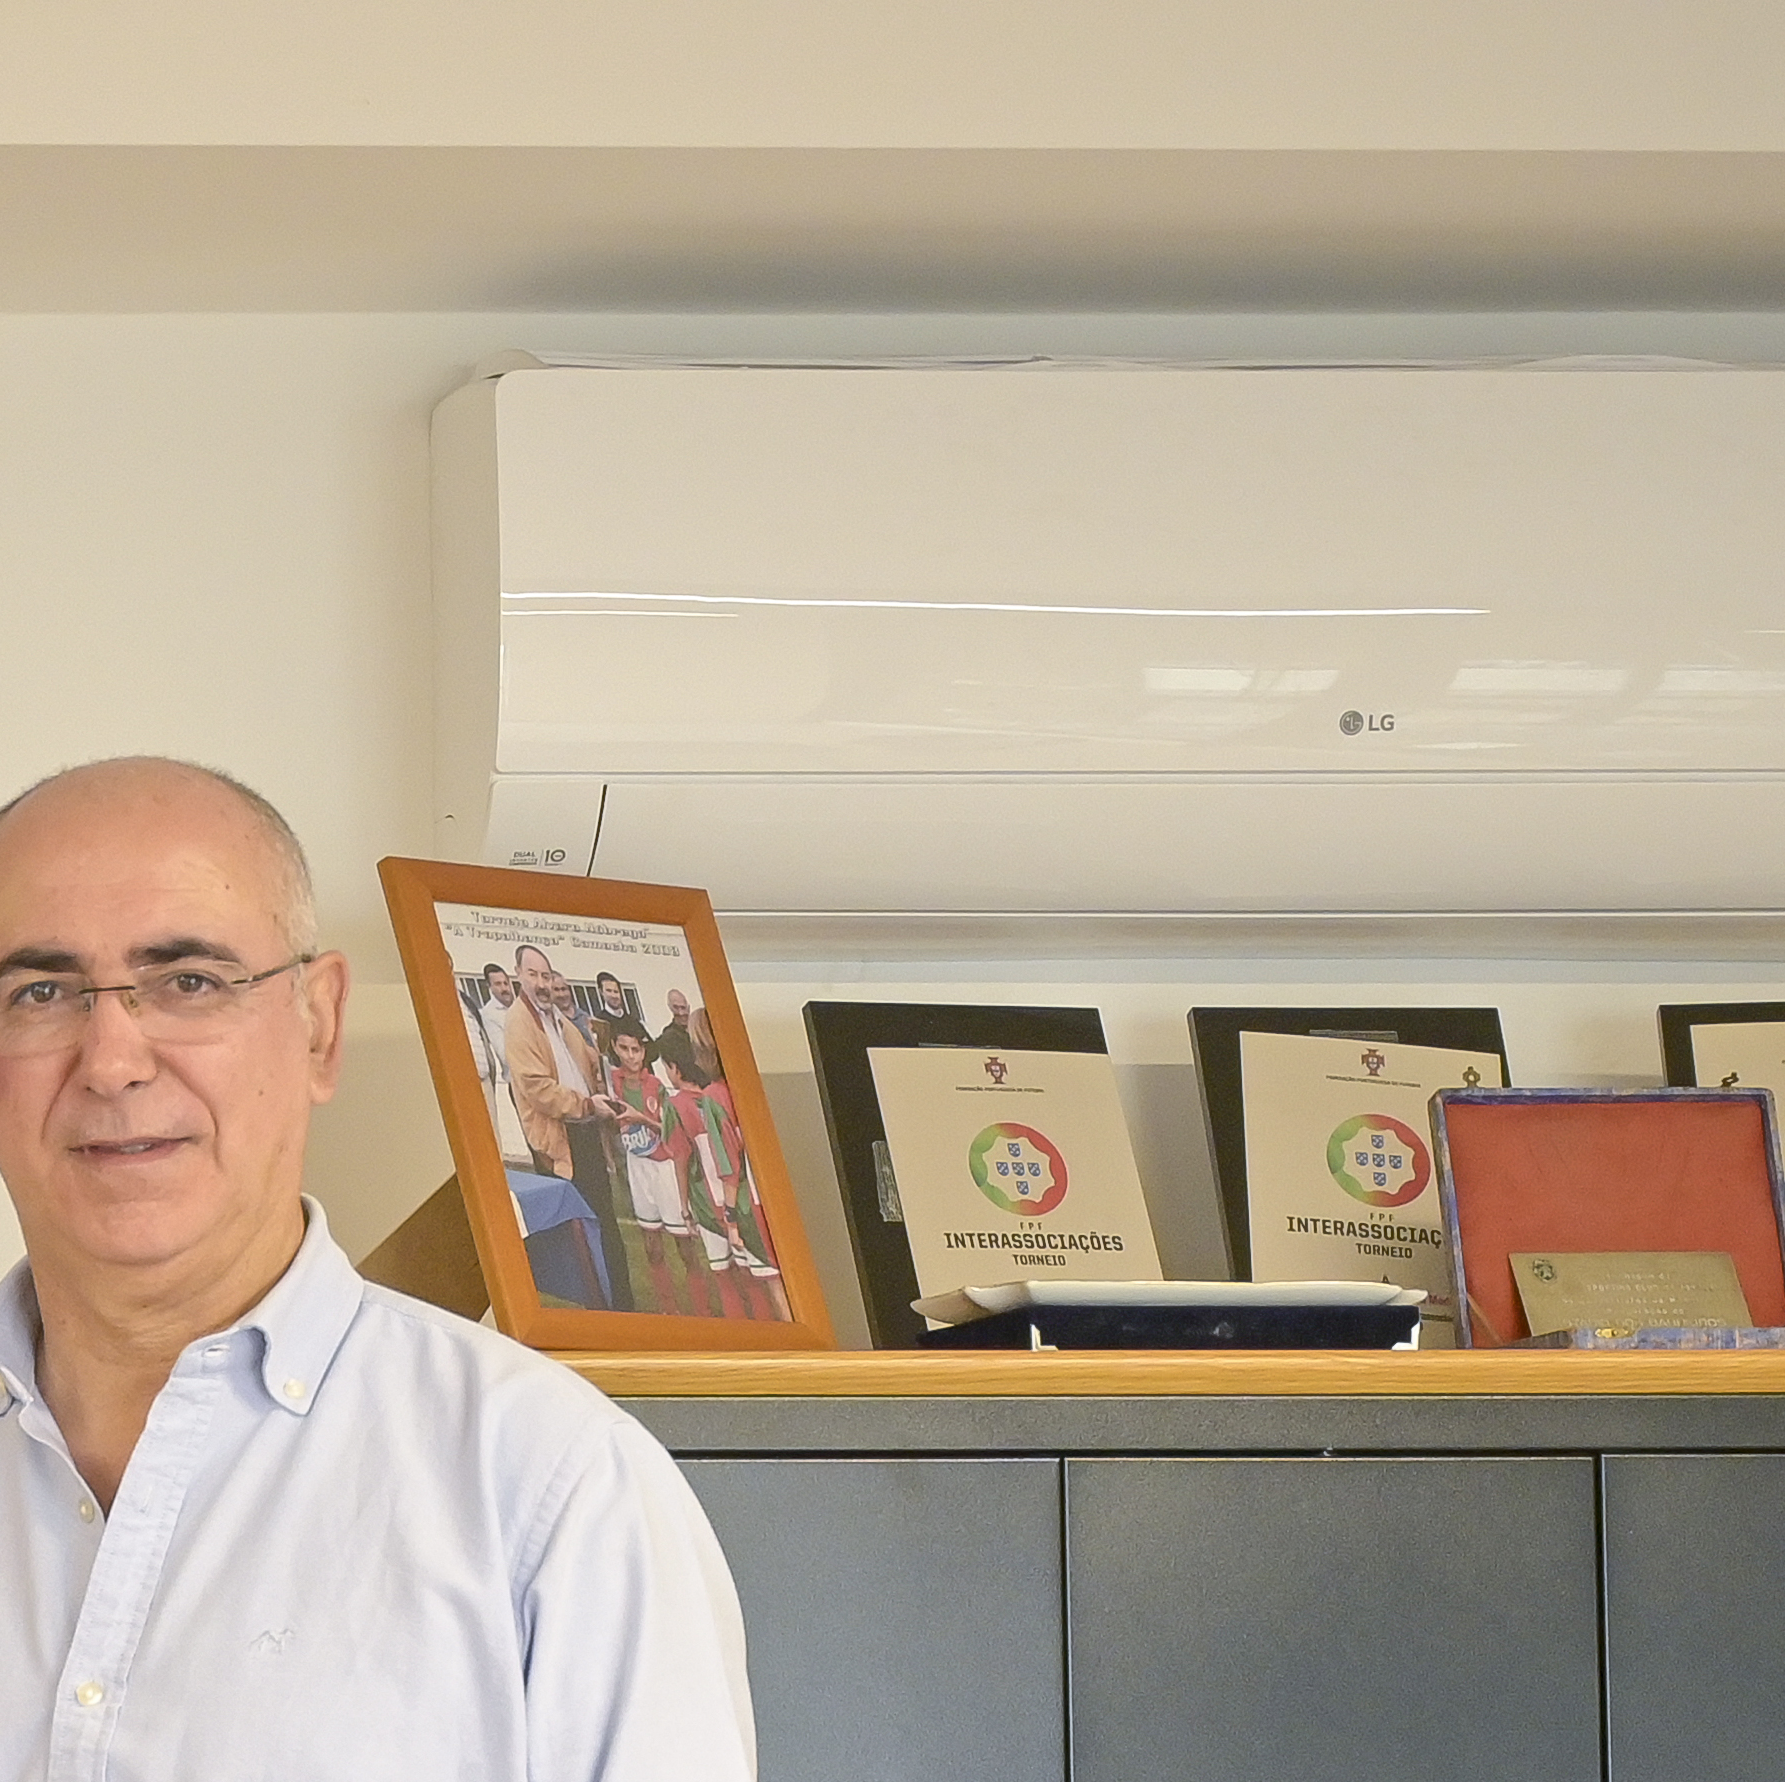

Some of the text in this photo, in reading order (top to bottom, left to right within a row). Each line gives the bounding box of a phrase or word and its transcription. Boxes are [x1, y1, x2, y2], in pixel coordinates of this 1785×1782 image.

[1368, 714, 1395, 731] LG
[1286, 1216, 1443, 1249] INTERASSOCIAÇ
[943, 1231, 1124, 1253] INTERASSOCIAÇÕES
[1355, 1243, 1413, 1259] TORNEIO
[1012, 1254, 1067, 1266] TORNEIO
